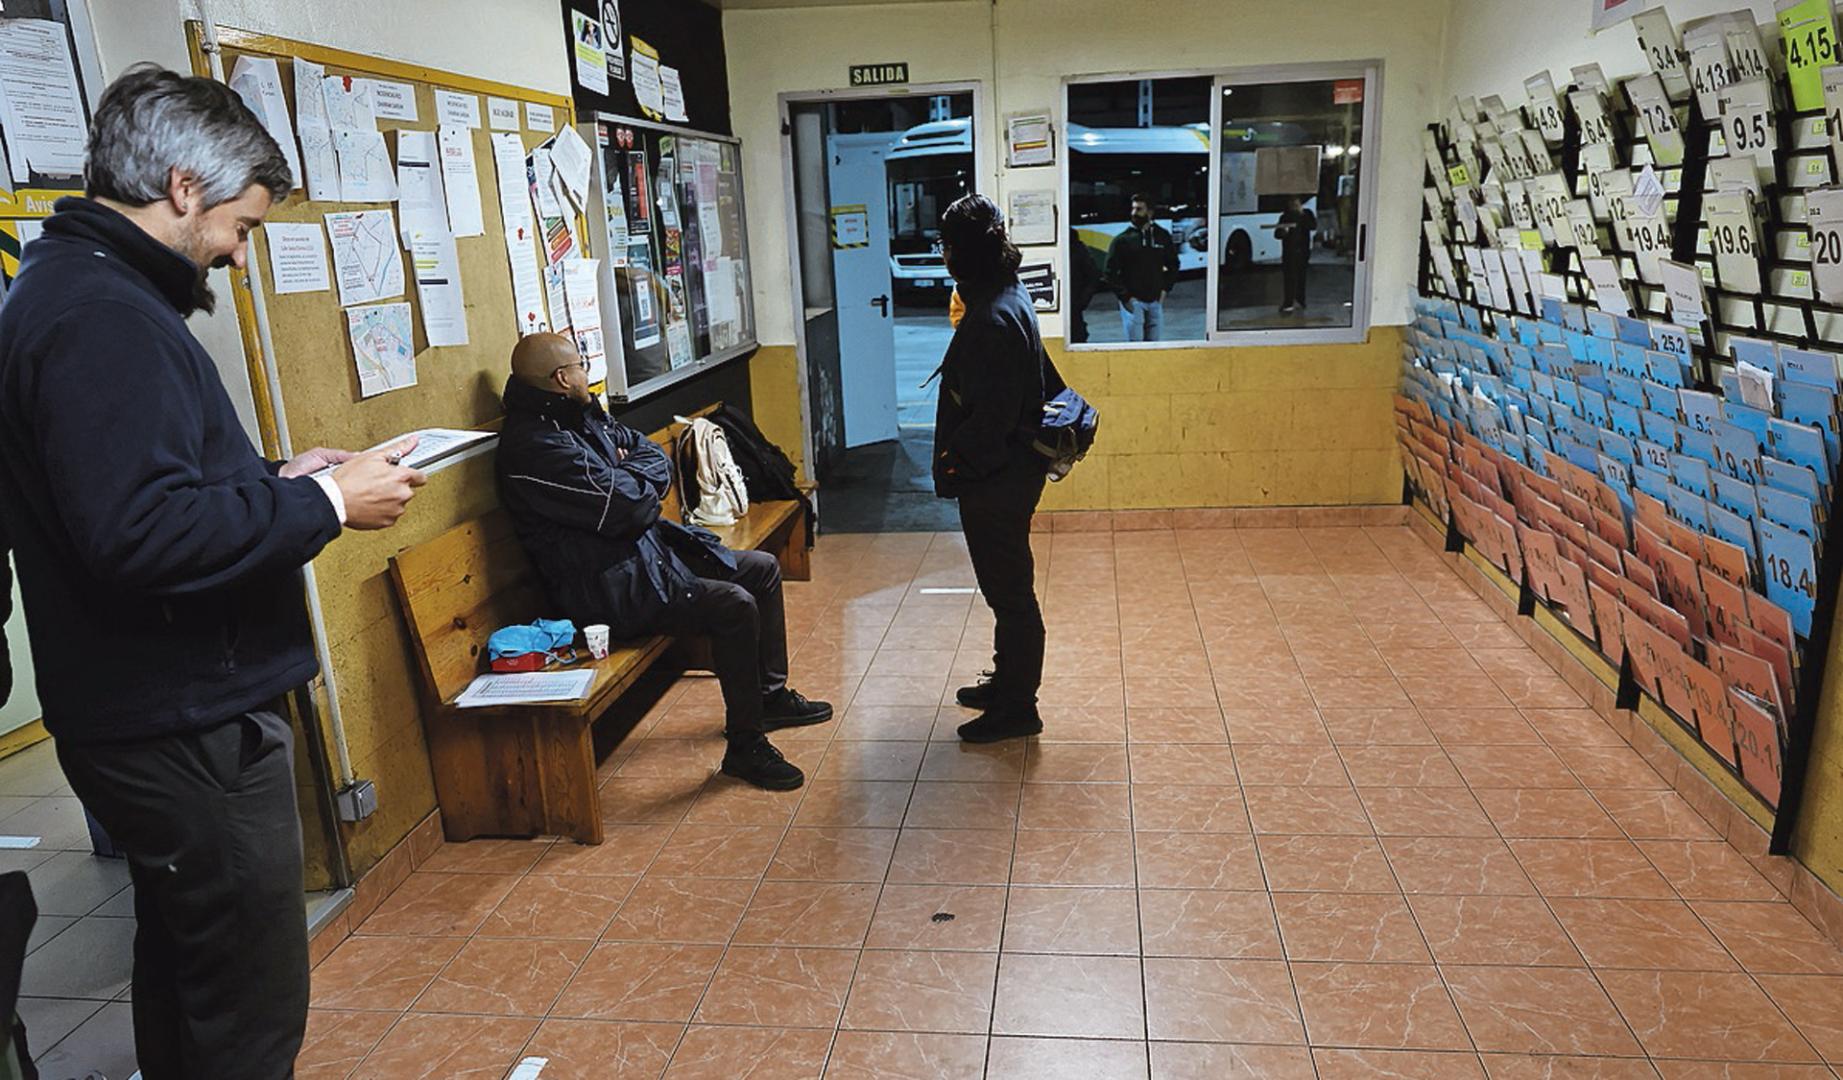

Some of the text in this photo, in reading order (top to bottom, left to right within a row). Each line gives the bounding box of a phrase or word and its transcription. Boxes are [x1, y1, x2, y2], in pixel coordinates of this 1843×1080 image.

[1652, 45, 1676, 70] 3.4
[1789, 27, 1832, 69] 4.15
[853, 66, 905, 83] SALIDA
[1735, 49, 1764, 77] 4.14
[1695, 63, 1727, 94] 4.13
[1539, 106, 1558, 130] 4.8
[1584, 117, 1608, 144] 6.4
[1643, 104, 1670, 135] 7.2
[1733, 114, 1766, 151] 9.5
[1590, 172, 1605, 197] 9.
[25, 196, 54, 214] Avis
[1634, 223, 1668, 252] 19.4
[1714, 225, 1750, 254] 19.6
[1661, 333, 1686, 354] 25.2
[1725, 452, 1756, 486] 9.3
[1768, 554, 1812, 598] 18.4
[1737, 722, 1774, 772] 20.1
